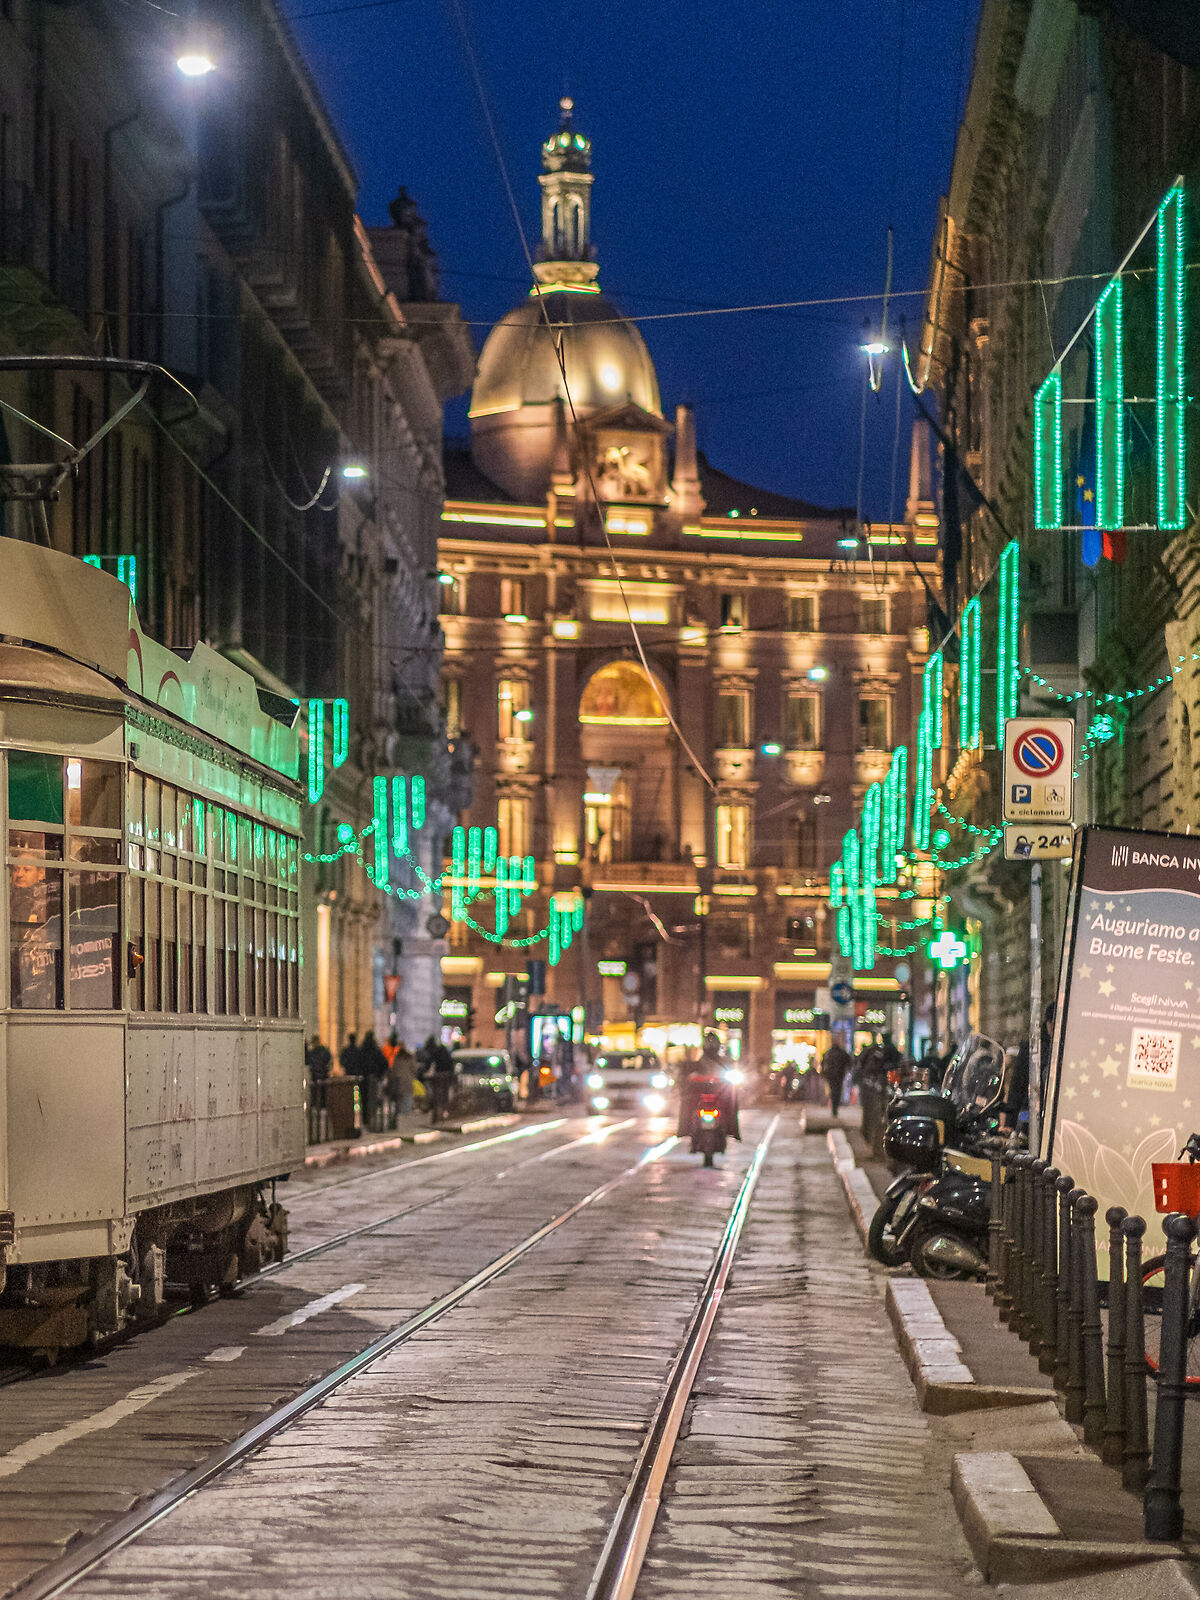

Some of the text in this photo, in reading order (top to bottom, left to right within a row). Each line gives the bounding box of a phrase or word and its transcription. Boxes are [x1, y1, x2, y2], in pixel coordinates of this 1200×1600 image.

[1015, 786, 1028, 802] P
[1132, 851, 1179, 869] BANCA
[1090, 913, 1186, 940] Auguriamo
[1089, 937, 1196, 966] Buone Feste.
[1130, 992, 1157, 1006] Scegli
